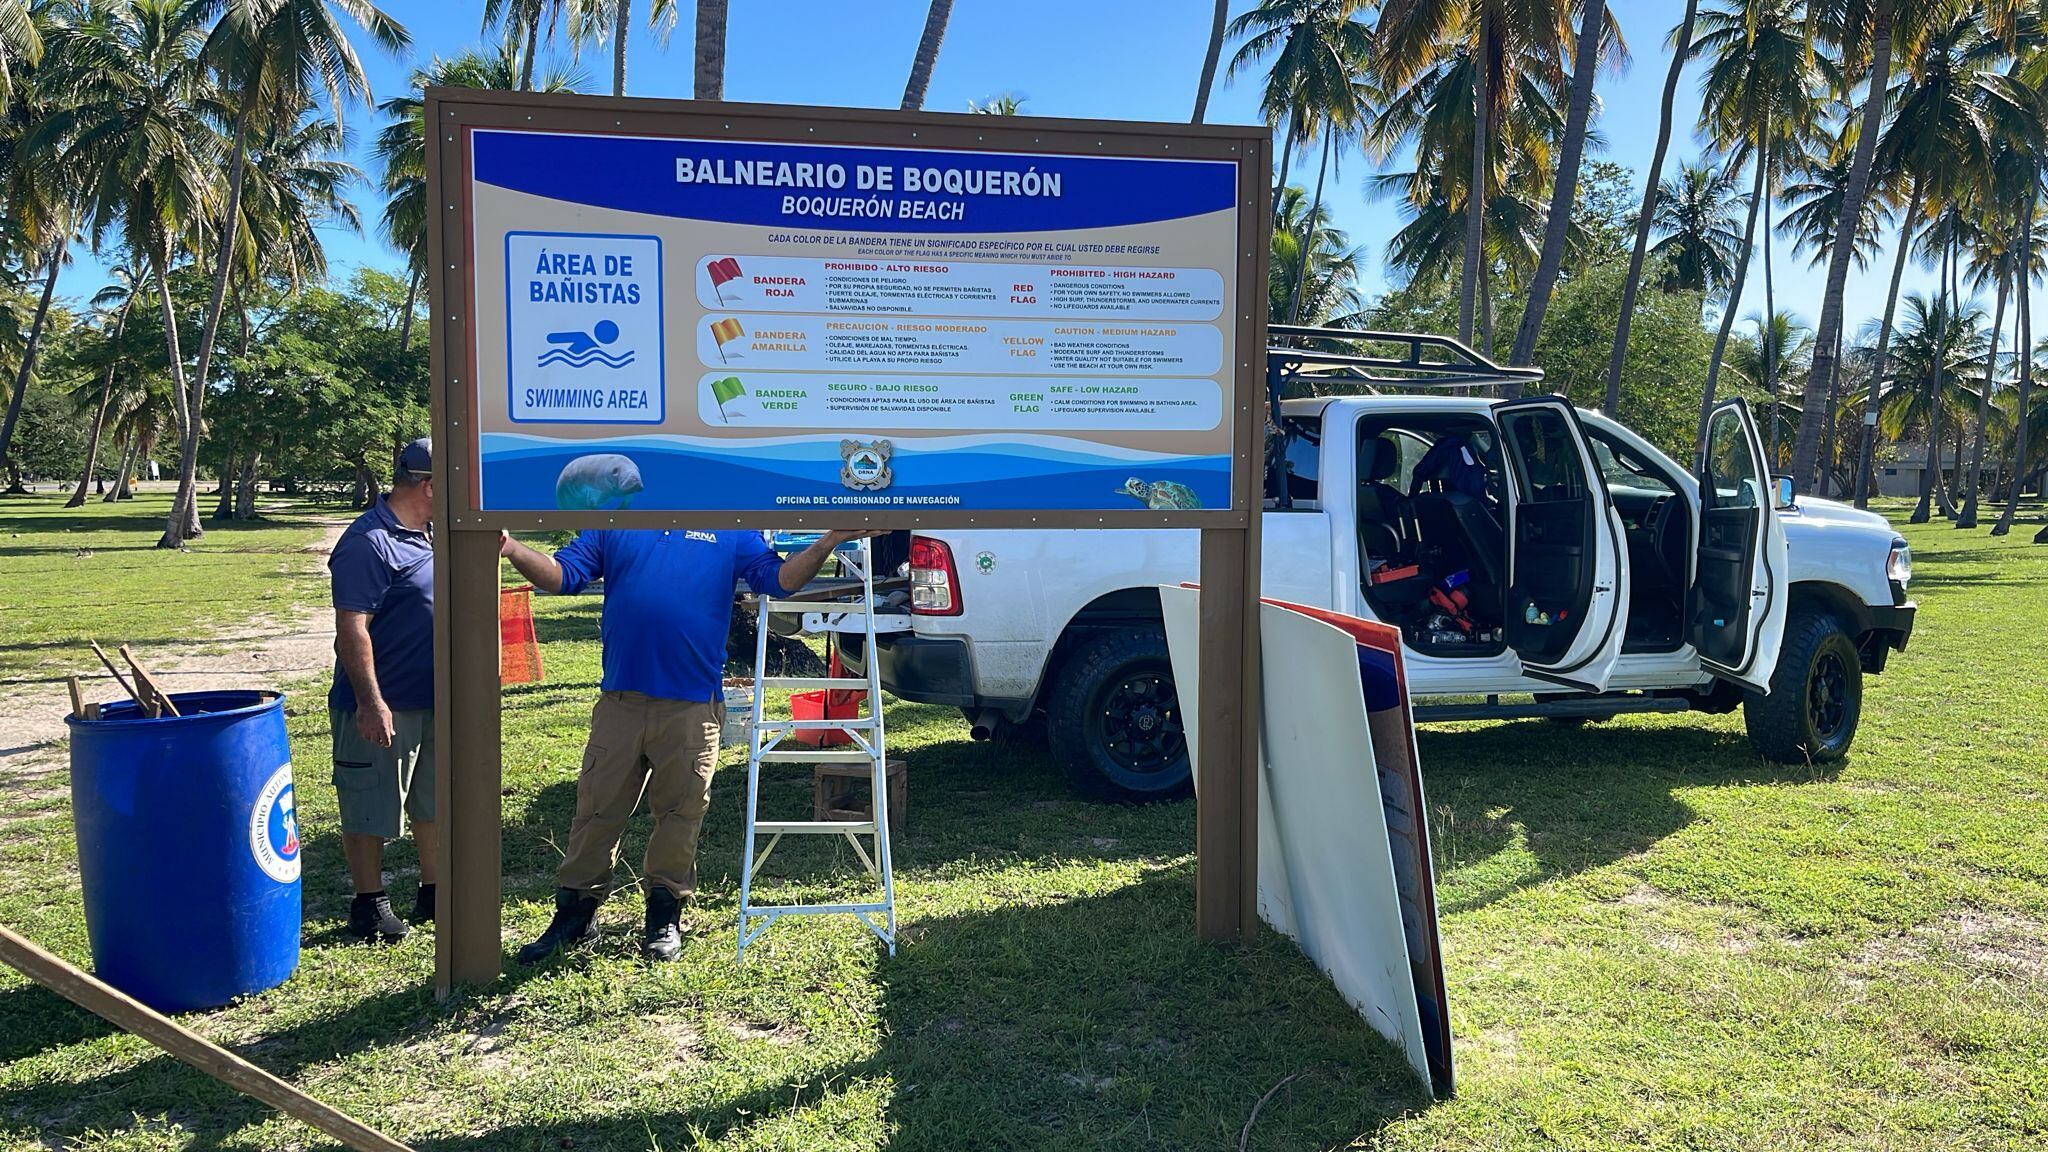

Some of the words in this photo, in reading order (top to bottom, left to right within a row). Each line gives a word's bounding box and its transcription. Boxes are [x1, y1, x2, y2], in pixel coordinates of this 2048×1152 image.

[676, 158, 847, 189] BALNEARIO
[857, 165, 893, 191] DE
[904, 167, 1061, 197] BOQUERÓN
[781, 194, 894, 218] BOQUERÓN
[899, 201, 965, 220] BEACH
[767, 234, 792, 243] CADA
[792, 235, 822, 244] COLOR
[822, 236, 835, 244] DE
[835, 236, 848, 245] LA
[848, 236, 888, 246] BANDERA
[888, 238, 913, 247] TIENE
[913, 238, 926, 247] UN
[926, 239, 978, 249] SIGNIFICADO
[978, 239, 1026, 250] ESPECÍFICO
[1026, 242, 1044, 251] POR
[1044, 242, 1055, 251] EL
[1055, 243, 1078, 252] CUAL
[1077, 243, 1104, 252] USTED
[1104, 244, 1126, 253] DEBE
[1126, 245, 1161, 254] REGIRSE
[536, 248, 596, 275] ÁREA
[604, 255, 632, 276] DE
[825, 263, 878, 272] PROHIBIDO
[886, 264, 911, 272] ALTO
[912, 265, 949, 274] RIESGO
[1050, 270, 1106, 278] PROHIBITED
[1138, 272, 1175, 280] HAZARD
[754, 276, 806, 285] BANDERA
[530, 277, 640, 305] BAÑISTAS
[1013, 284, 1033, 292] RED
[766, 289, 794, 297] ROJA
[1010, 296, 1037, 304] FLAG
[934, 325, 987, 333] MODERADO
[754, 331, 806, 340] BANDERA
[1003, 337, 1044, 345] YELLOW
[751, 343, 807, 352] AMARILLA
[1010, 349, 1036, 357] FLAG
[525, 388, 603, 408] SWIMMING
[607, 390, 648, 409] AREA
[755, 390, 807, 398] BANDERA
[1009, 393, 1044, 401] GREEN
[762, 402, 798, 410] VERDE
[1014, 405, 1040, 413] FLAG
[776, 496, 811, 504] OFICINA
[812, 496, 830, 504] DEL
[831, 496, 891, 505] COMISIONADO
[892, 496, 904, 505] DE
[906, 495, 960, 505] NAVEGACIÓN
[256, 804, 274, 866] MUNICIPIO
